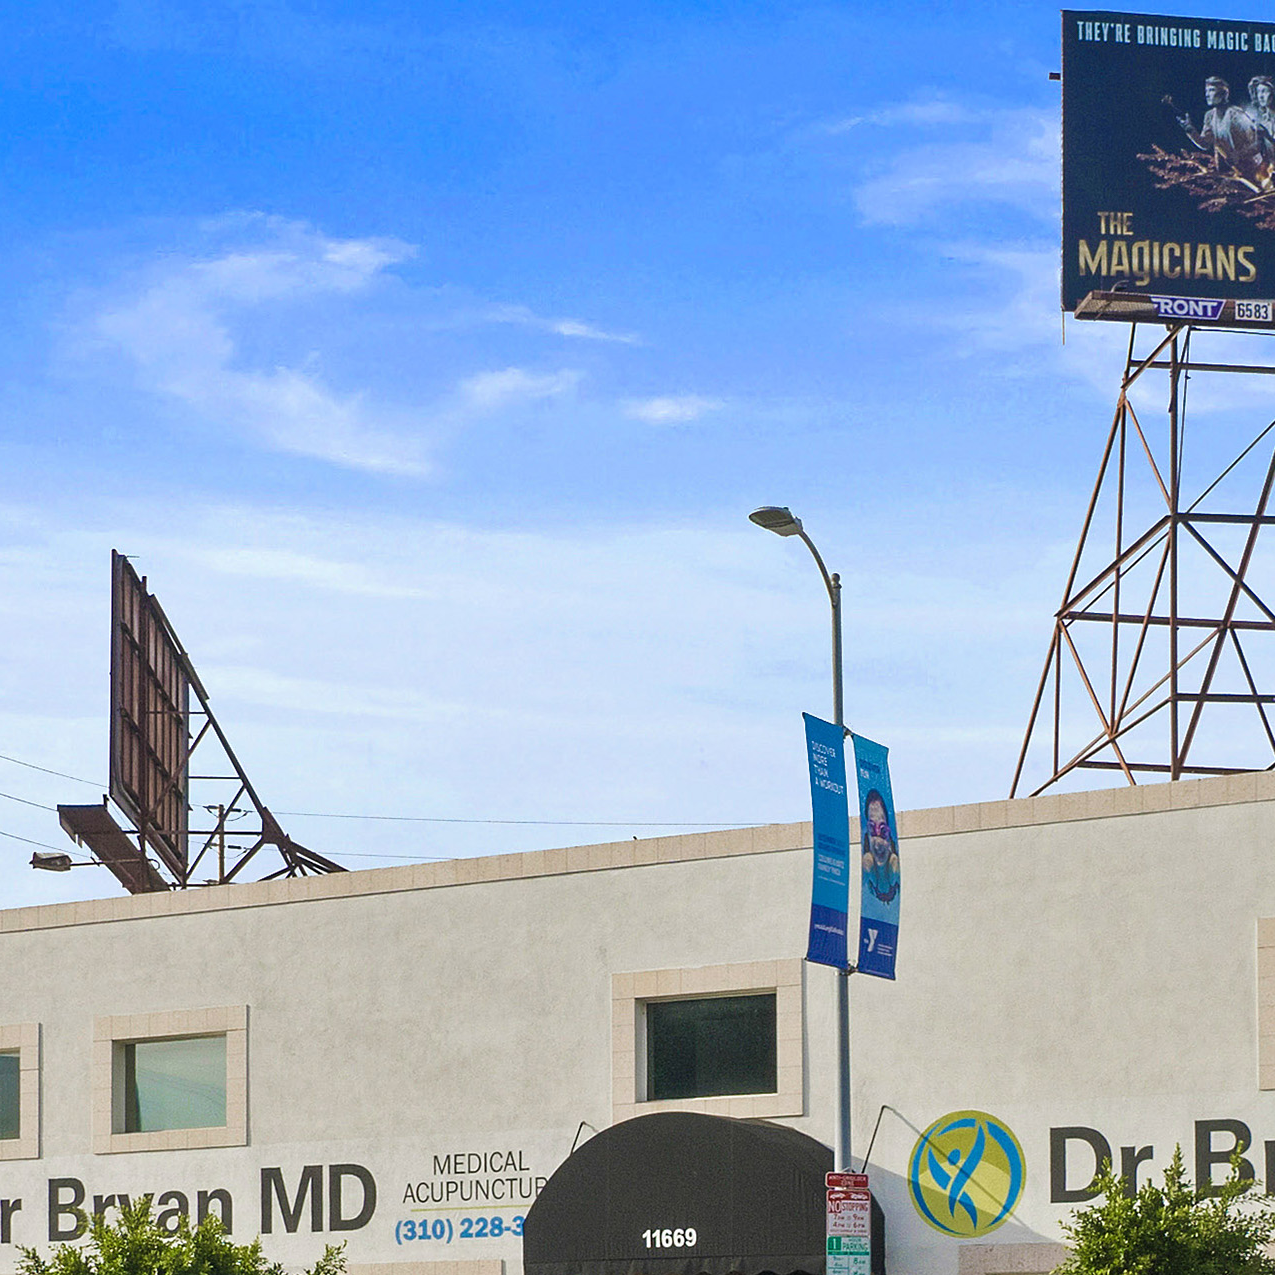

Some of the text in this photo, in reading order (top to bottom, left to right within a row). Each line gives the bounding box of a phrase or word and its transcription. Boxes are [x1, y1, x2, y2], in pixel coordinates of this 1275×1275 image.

[1077, 21, 1131, 43] THEY'RE
[1137, 25, 1200, 48] BRINGING
[1207, 30, 1248, 51] MAGIC
[1097, 211, 1134, 236] THE
[1237, 302, 1268, 319] 6583
[433, 1150, 530, 1176] MEDICAL
[1050, 1126, 1153, 1204] Dr
[261, 1164, 376, 1234] MD
[828, 1200, 869, 1212] NO STOPPING
[395, 1218, 453, 1245] (310)
[642, 1227, 697, 1248] 11669
[842, 1242, 869, 1250] PARKING
